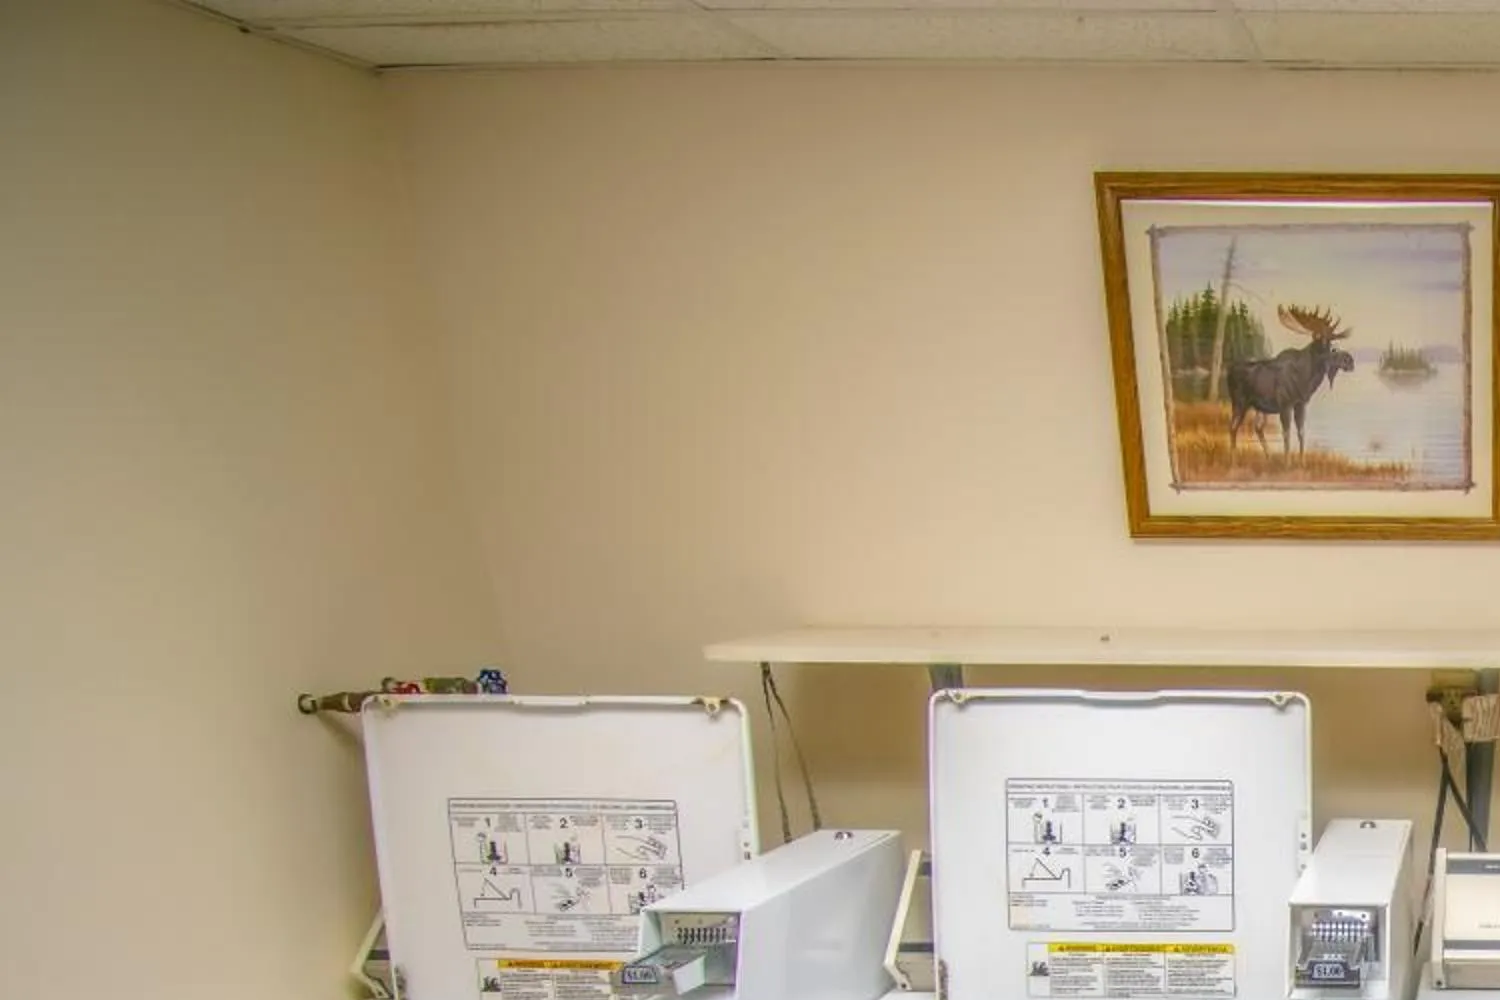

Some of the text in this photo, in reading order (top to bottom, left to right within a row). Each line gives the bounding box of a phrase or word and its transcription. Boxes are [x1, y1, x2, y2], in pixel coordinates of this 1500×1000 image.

[1042, 798, 1049, 808] 1
[1117, 798, 1126, 809] 2
[1191, 799, 1199, 809] 3
[485, 817, 491, 828] 1
[559, 818, 568, 829] 2
[634, 819, 643, 829] 3
[1042, 847, 1051, 856] 4
[1119, 847, 1127, 858] 5
[1192, 848, 1200, 858] 6
[489, 867, 497, 877] 4
[565, 867, 573, 878] 5
[639, 868, 647, 878] 6
